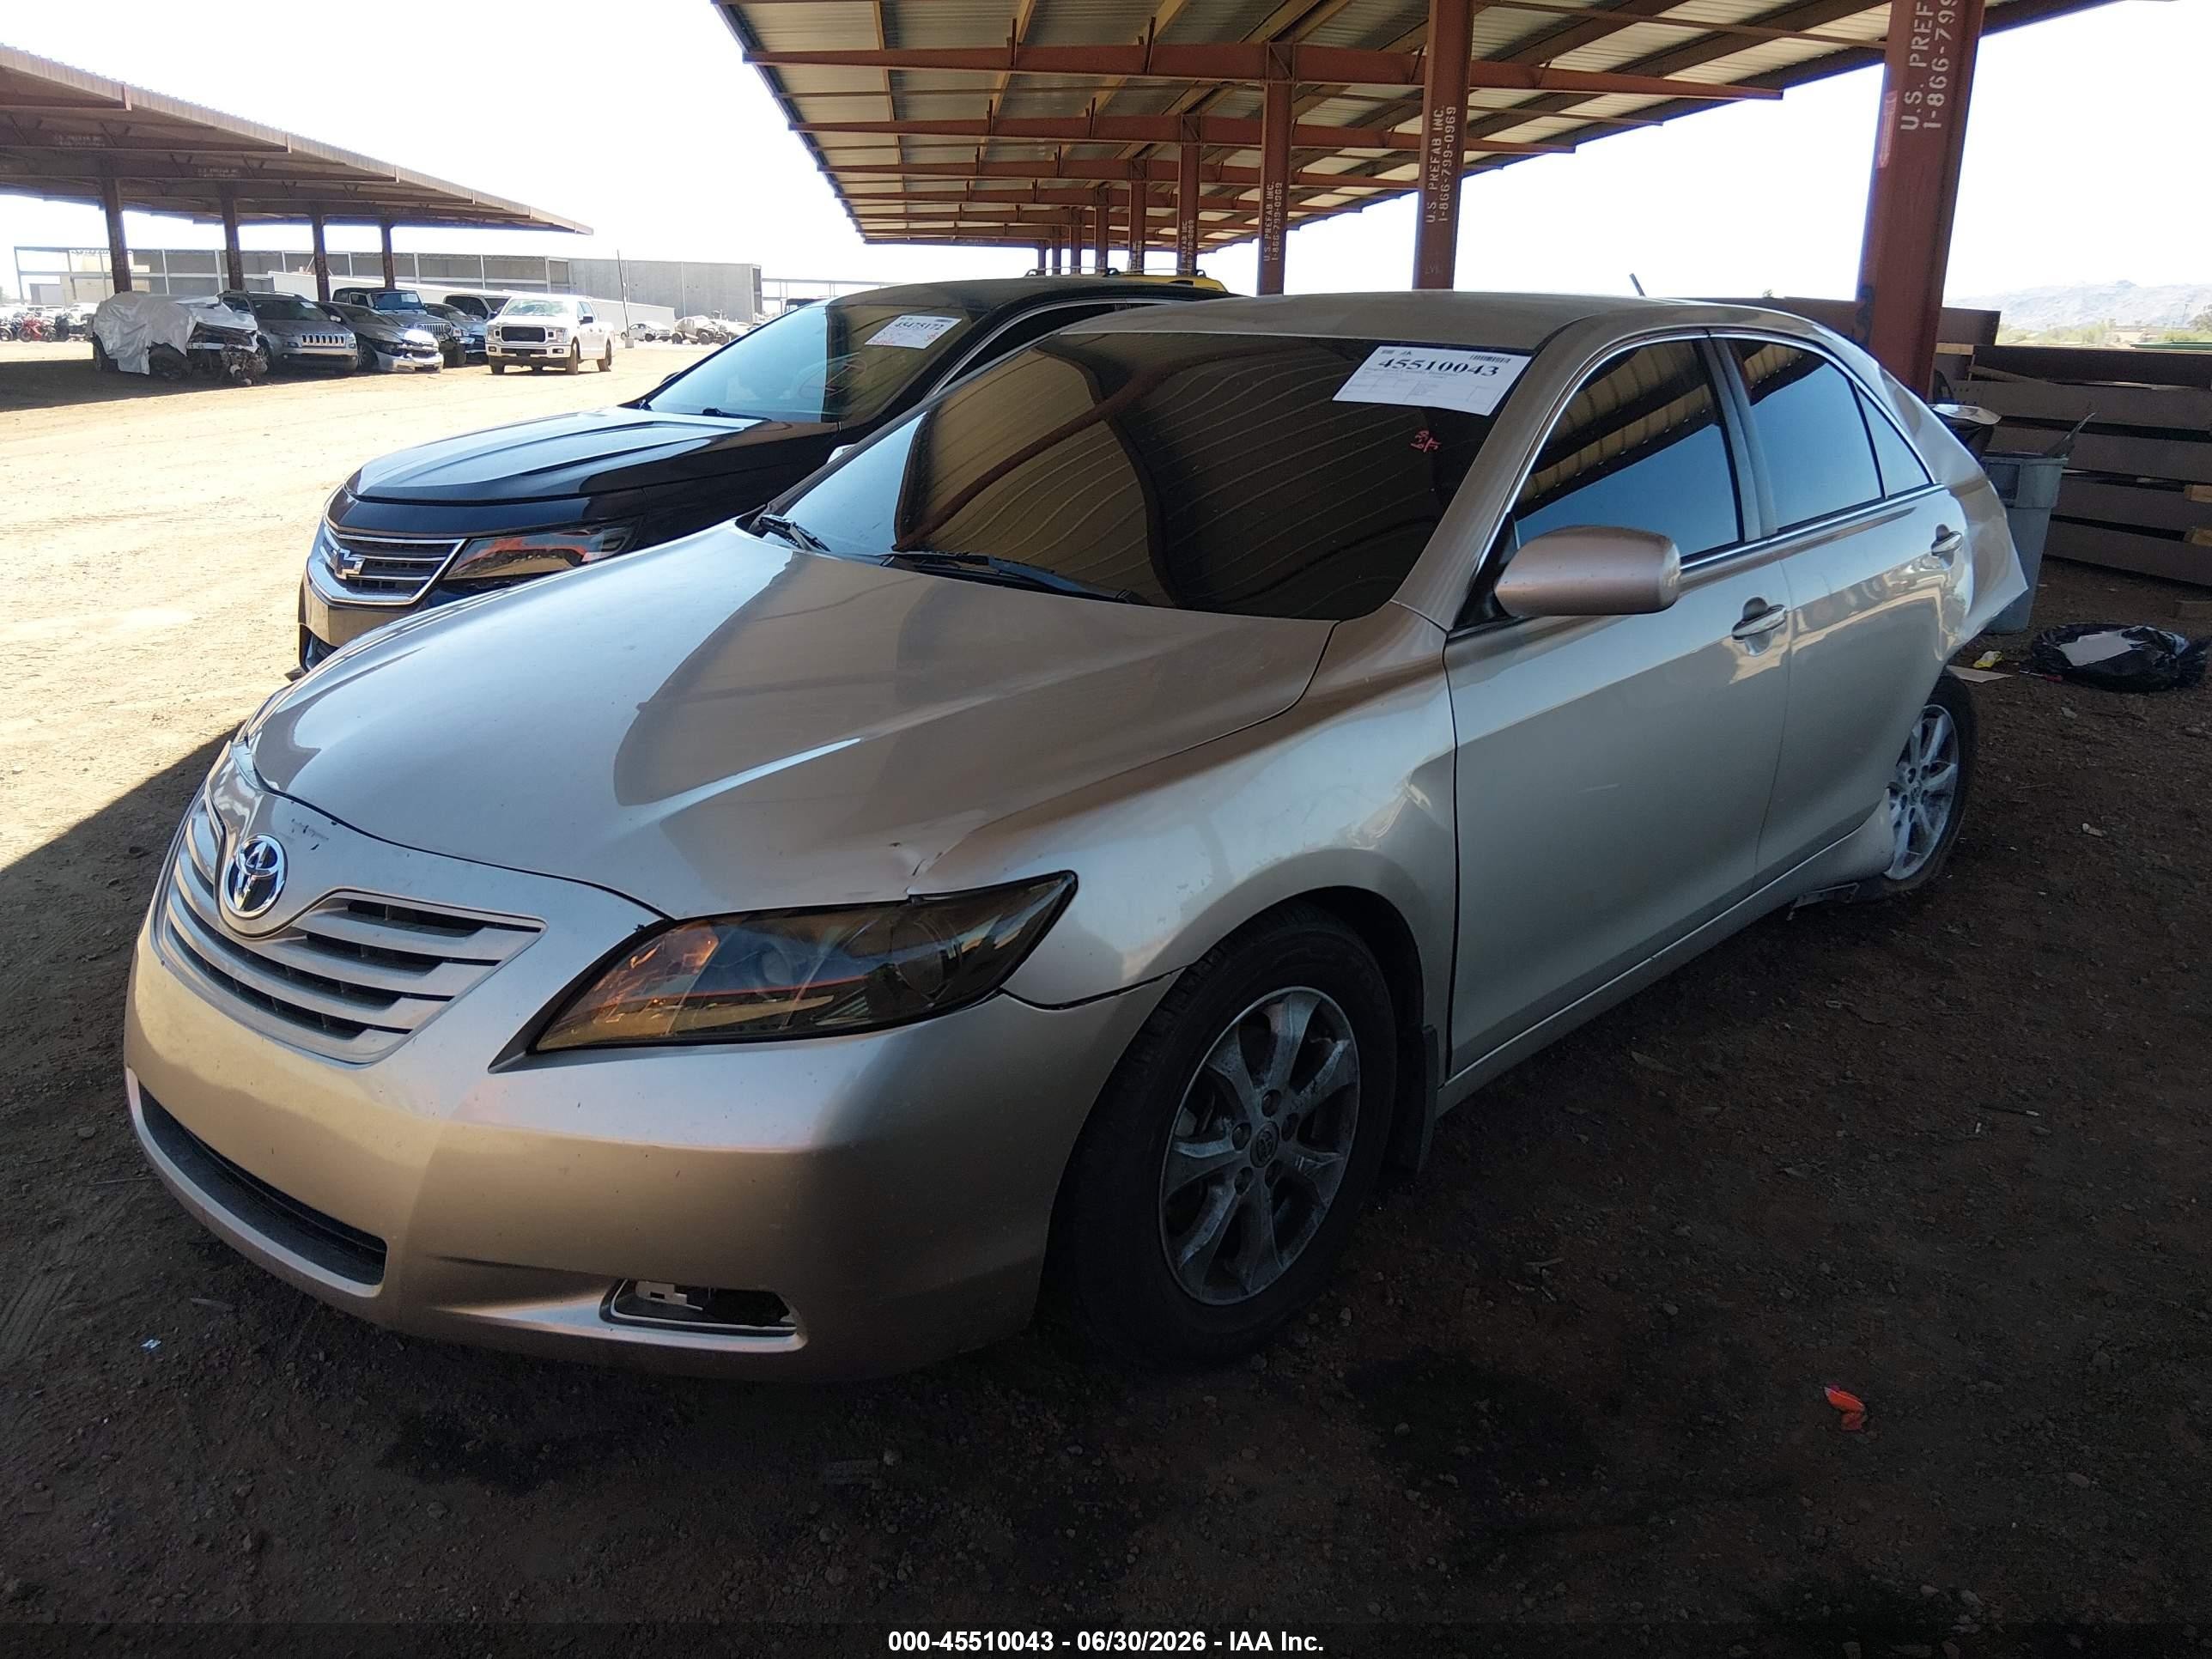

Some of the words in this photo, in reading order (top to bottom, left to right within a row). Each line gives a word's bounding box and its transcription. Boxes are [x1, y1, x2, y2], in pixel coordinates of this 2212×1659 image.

[1909, 2, 1934, 68] PREF
[1429, 137, 1443, 191] PREFAB
[1438, 106, 1457, 222] 1-866-799-0969
[1265, 204, 1273, 240] PREFAB
[1379, 358, 1499, 377] 45510043
